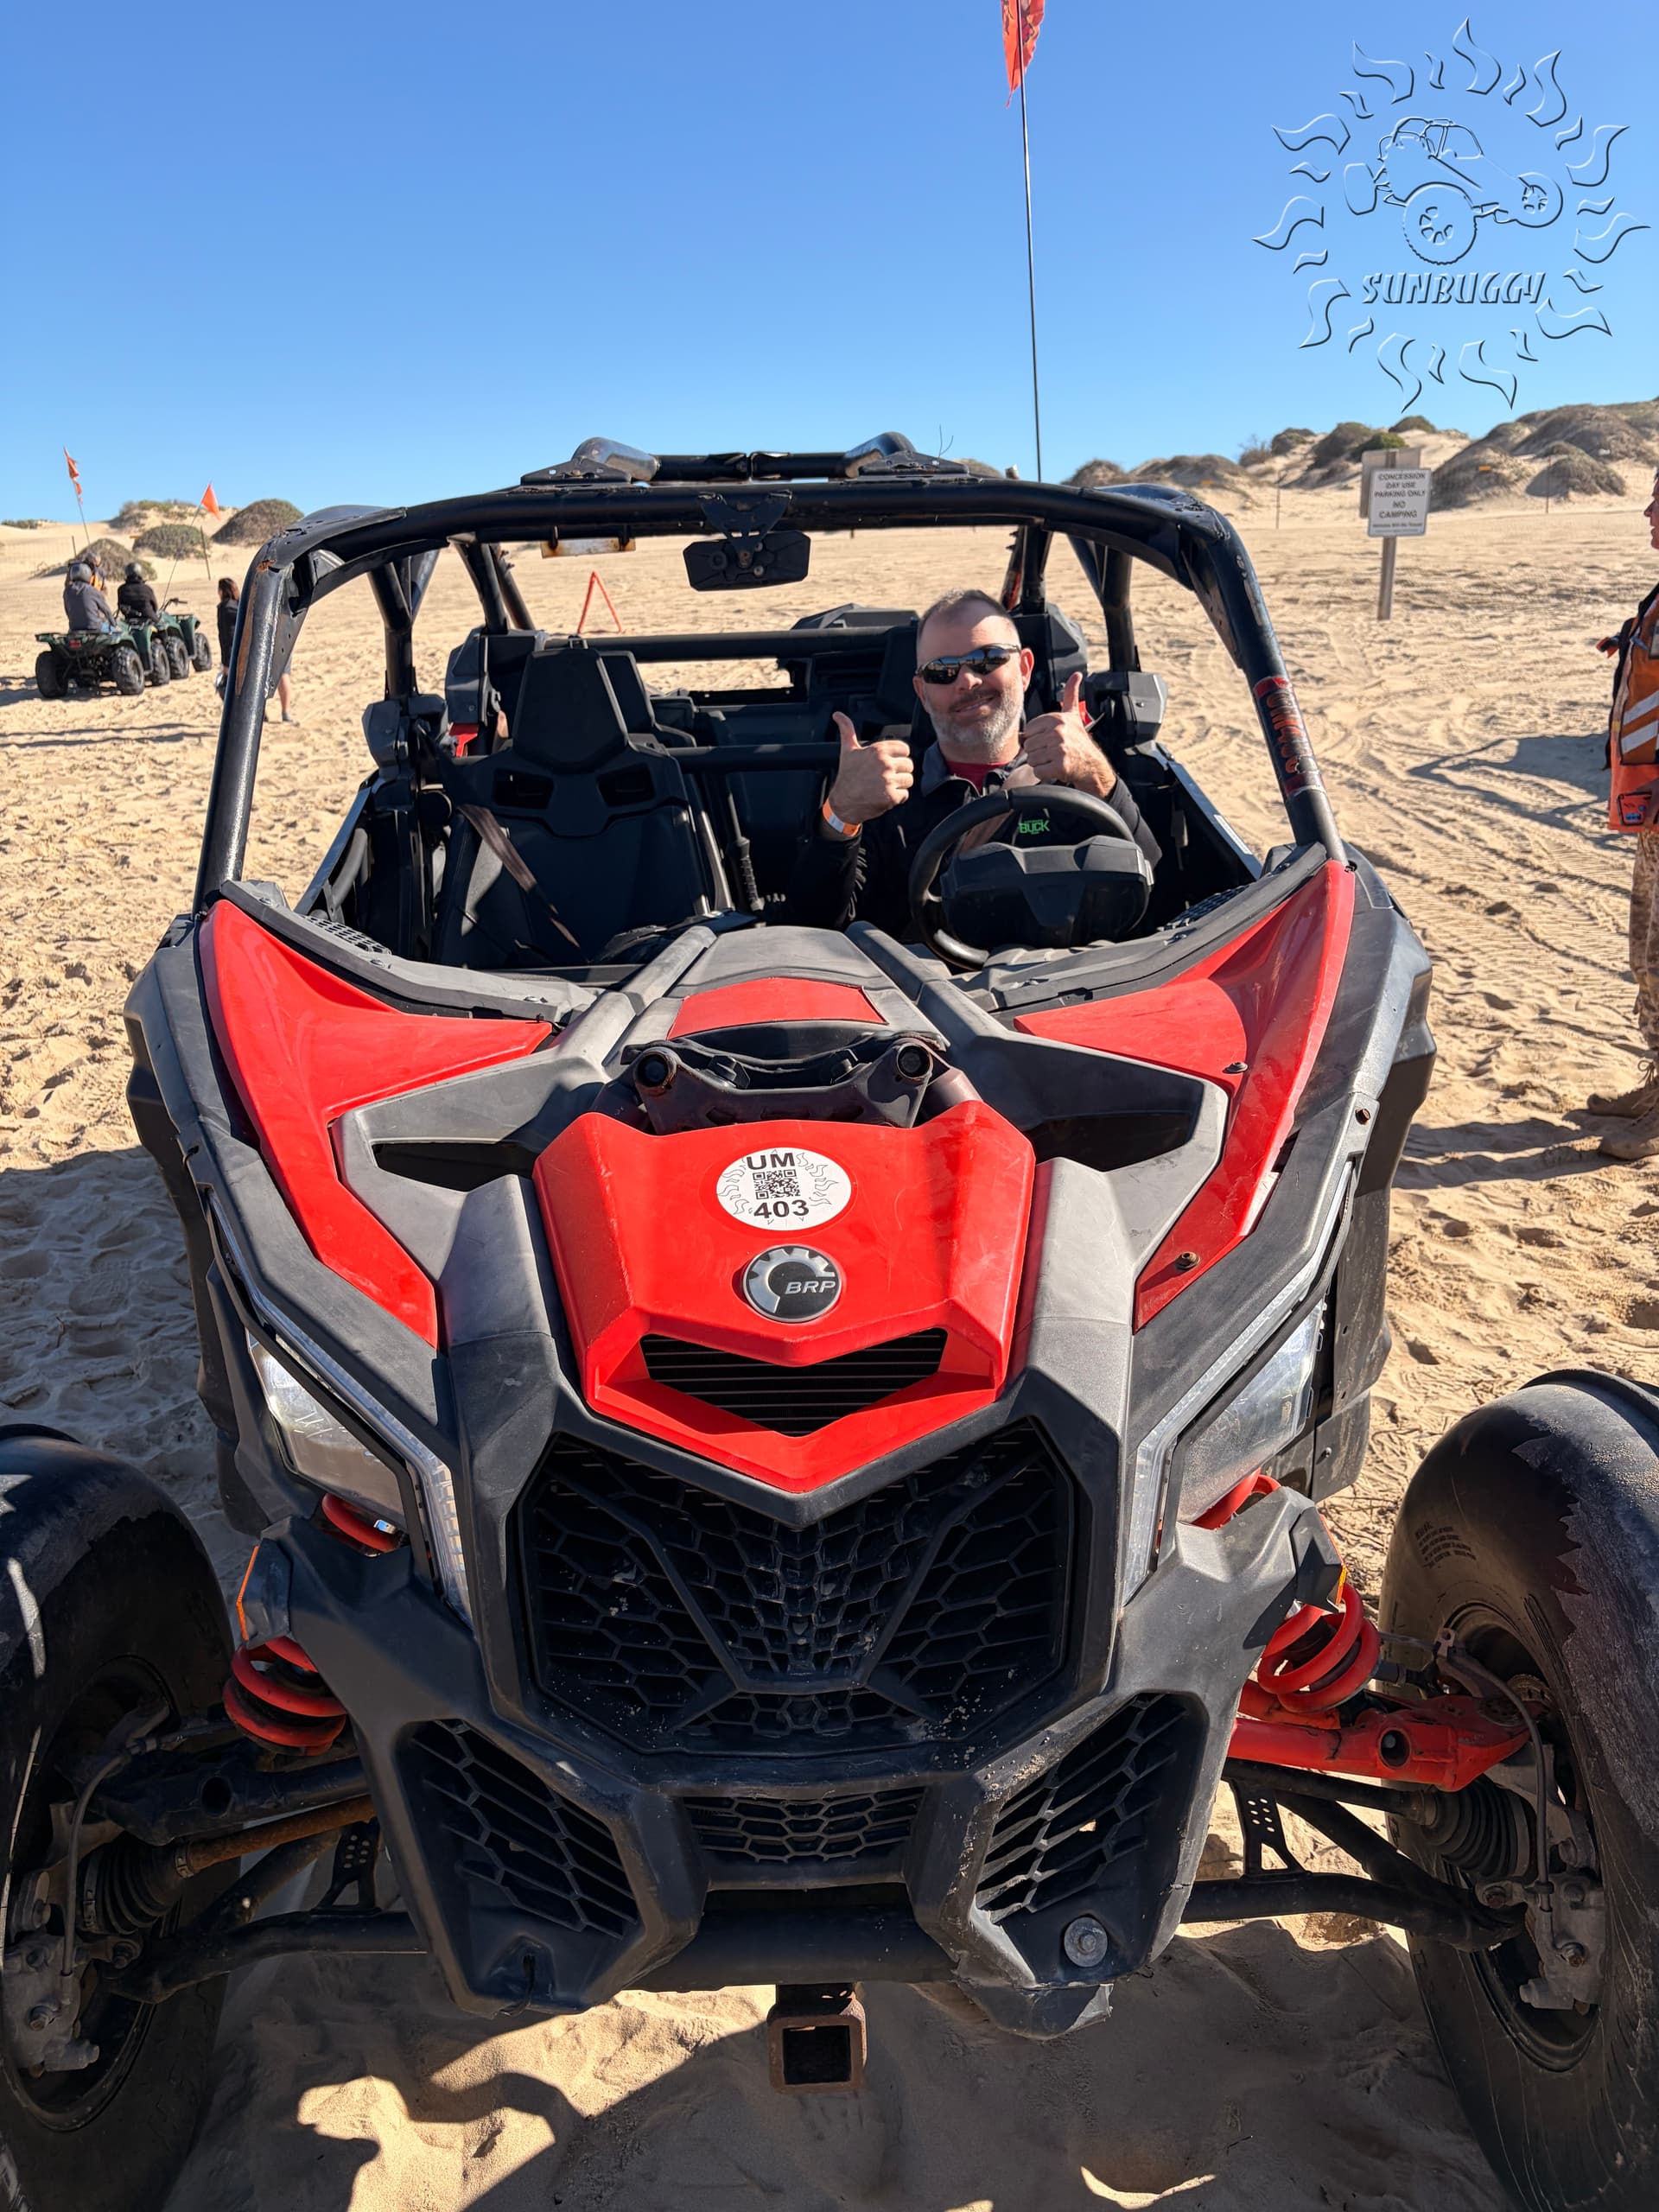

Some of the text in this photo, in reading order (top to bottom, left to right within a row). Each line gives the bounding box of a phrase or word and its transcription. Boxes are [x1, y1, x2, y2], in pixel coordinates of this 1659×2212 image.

[1378, 510, 1417, 518] CAMPING
[747, 1152, 796, 1171] UM
[753, 1199, 809, 1219] 403
[785, 1281, 836, 1294] BRP
